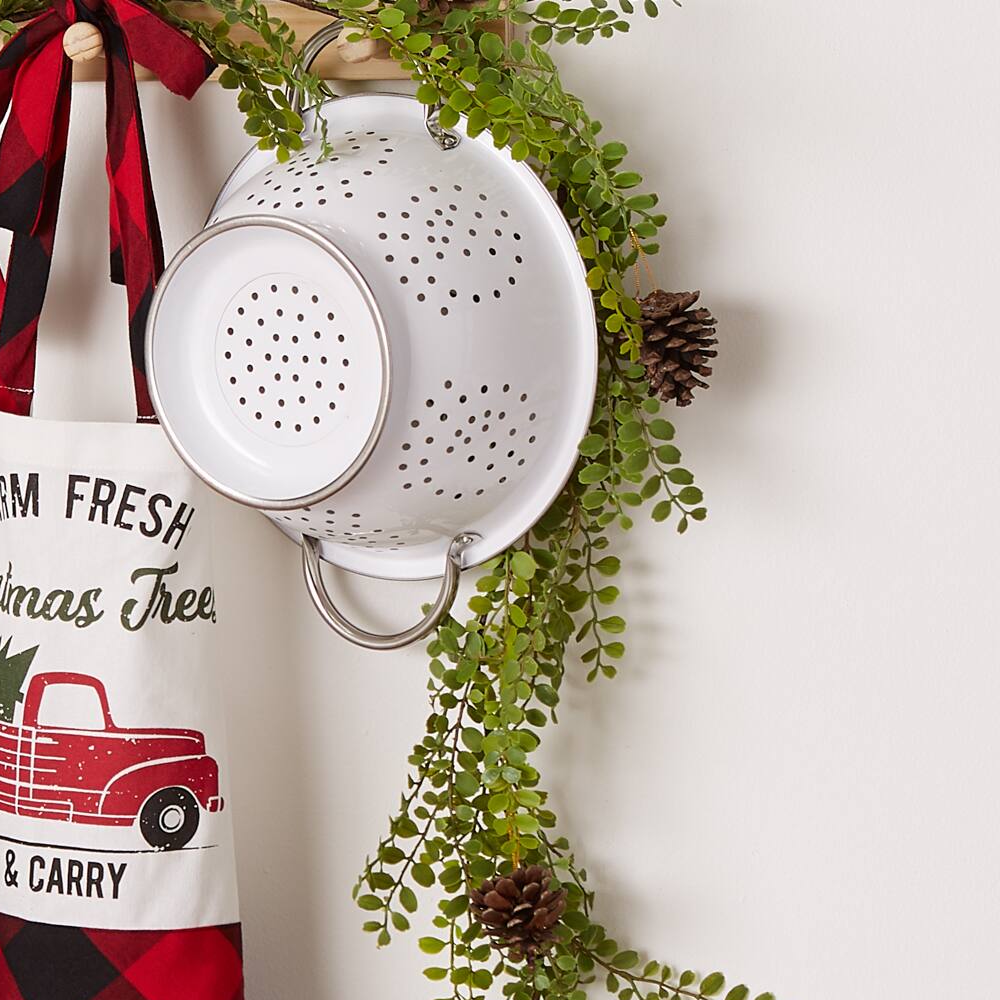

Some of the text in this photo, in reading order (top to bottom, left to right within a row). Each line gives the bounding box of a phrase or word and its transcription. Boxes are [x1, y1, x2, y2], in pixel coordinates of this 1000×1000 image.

[65, 474, 195, 549] FRESH
[120, 561, 216, 631] Tree
[5, 849, 18, 888] &
[29, 855, 127, 899] CARRY
